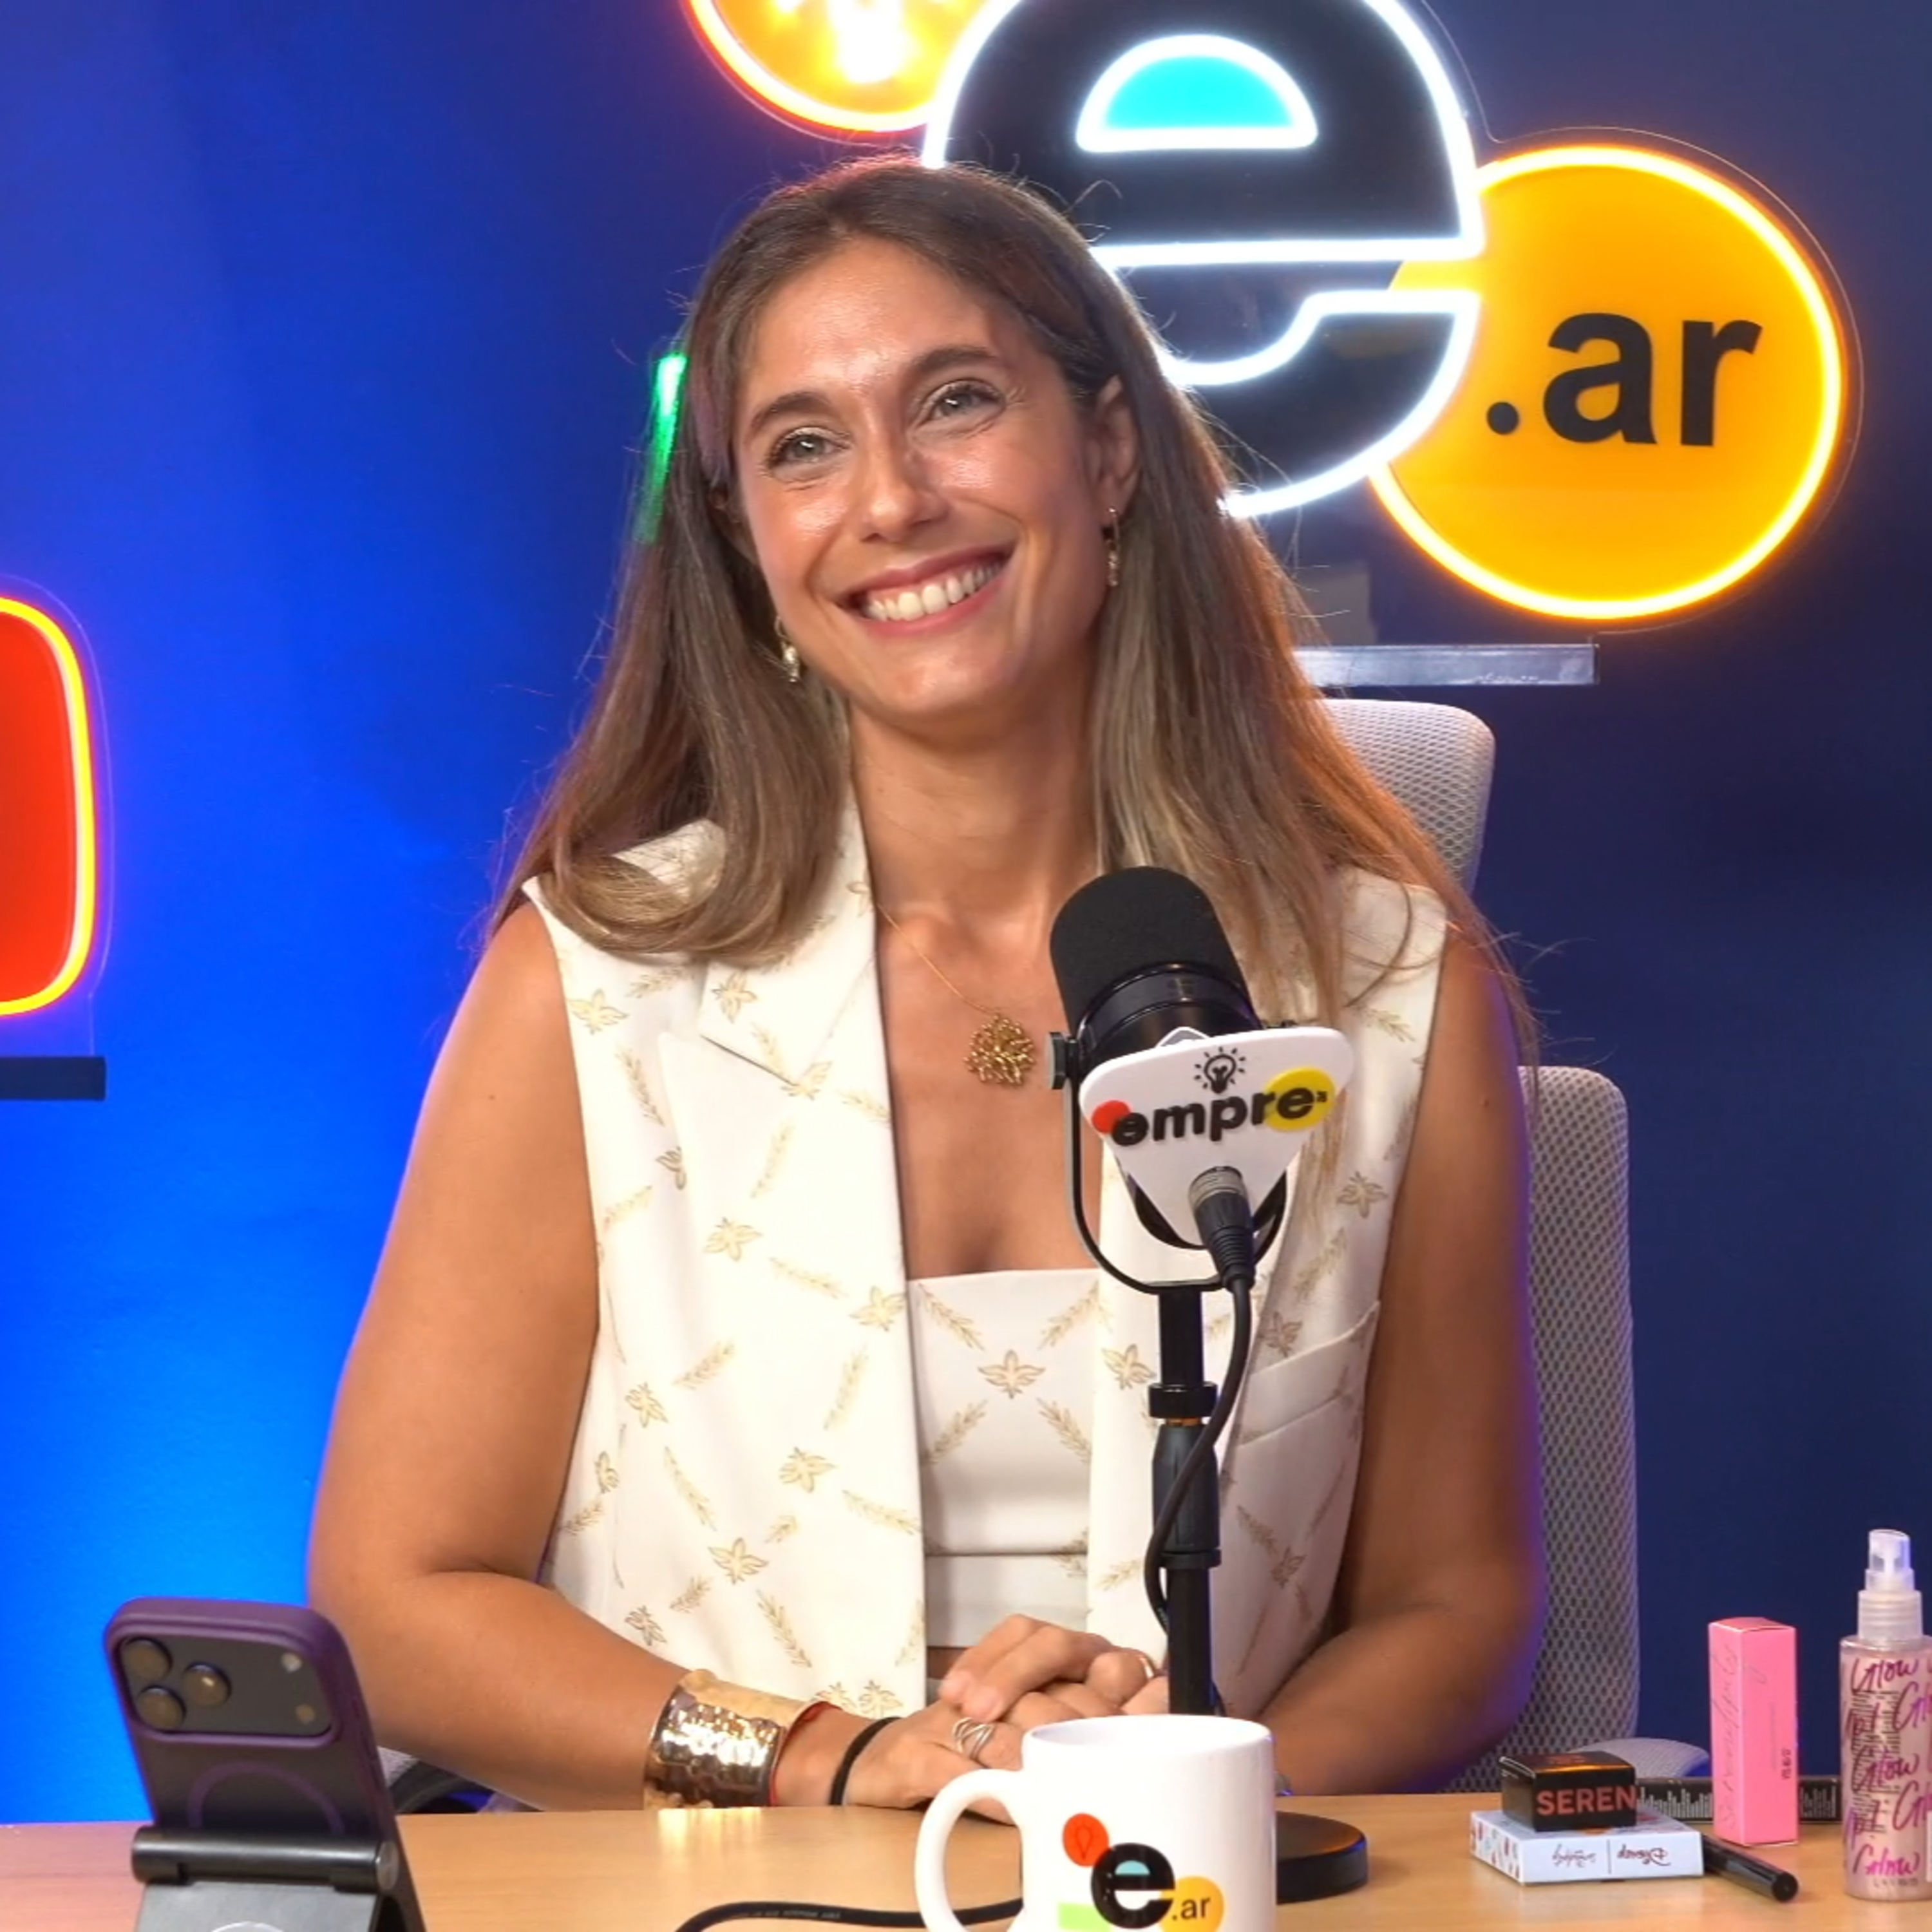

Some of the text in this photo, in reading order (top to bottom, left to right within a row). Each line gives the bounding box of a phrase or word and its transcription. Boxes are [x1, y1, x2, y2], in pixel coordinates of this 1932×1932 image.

[1484, 311, 1762, 449] .ar
[1536, 1785, 1637, 1816] SEREN
[1171, 1895, 1210, 1921] .ar
